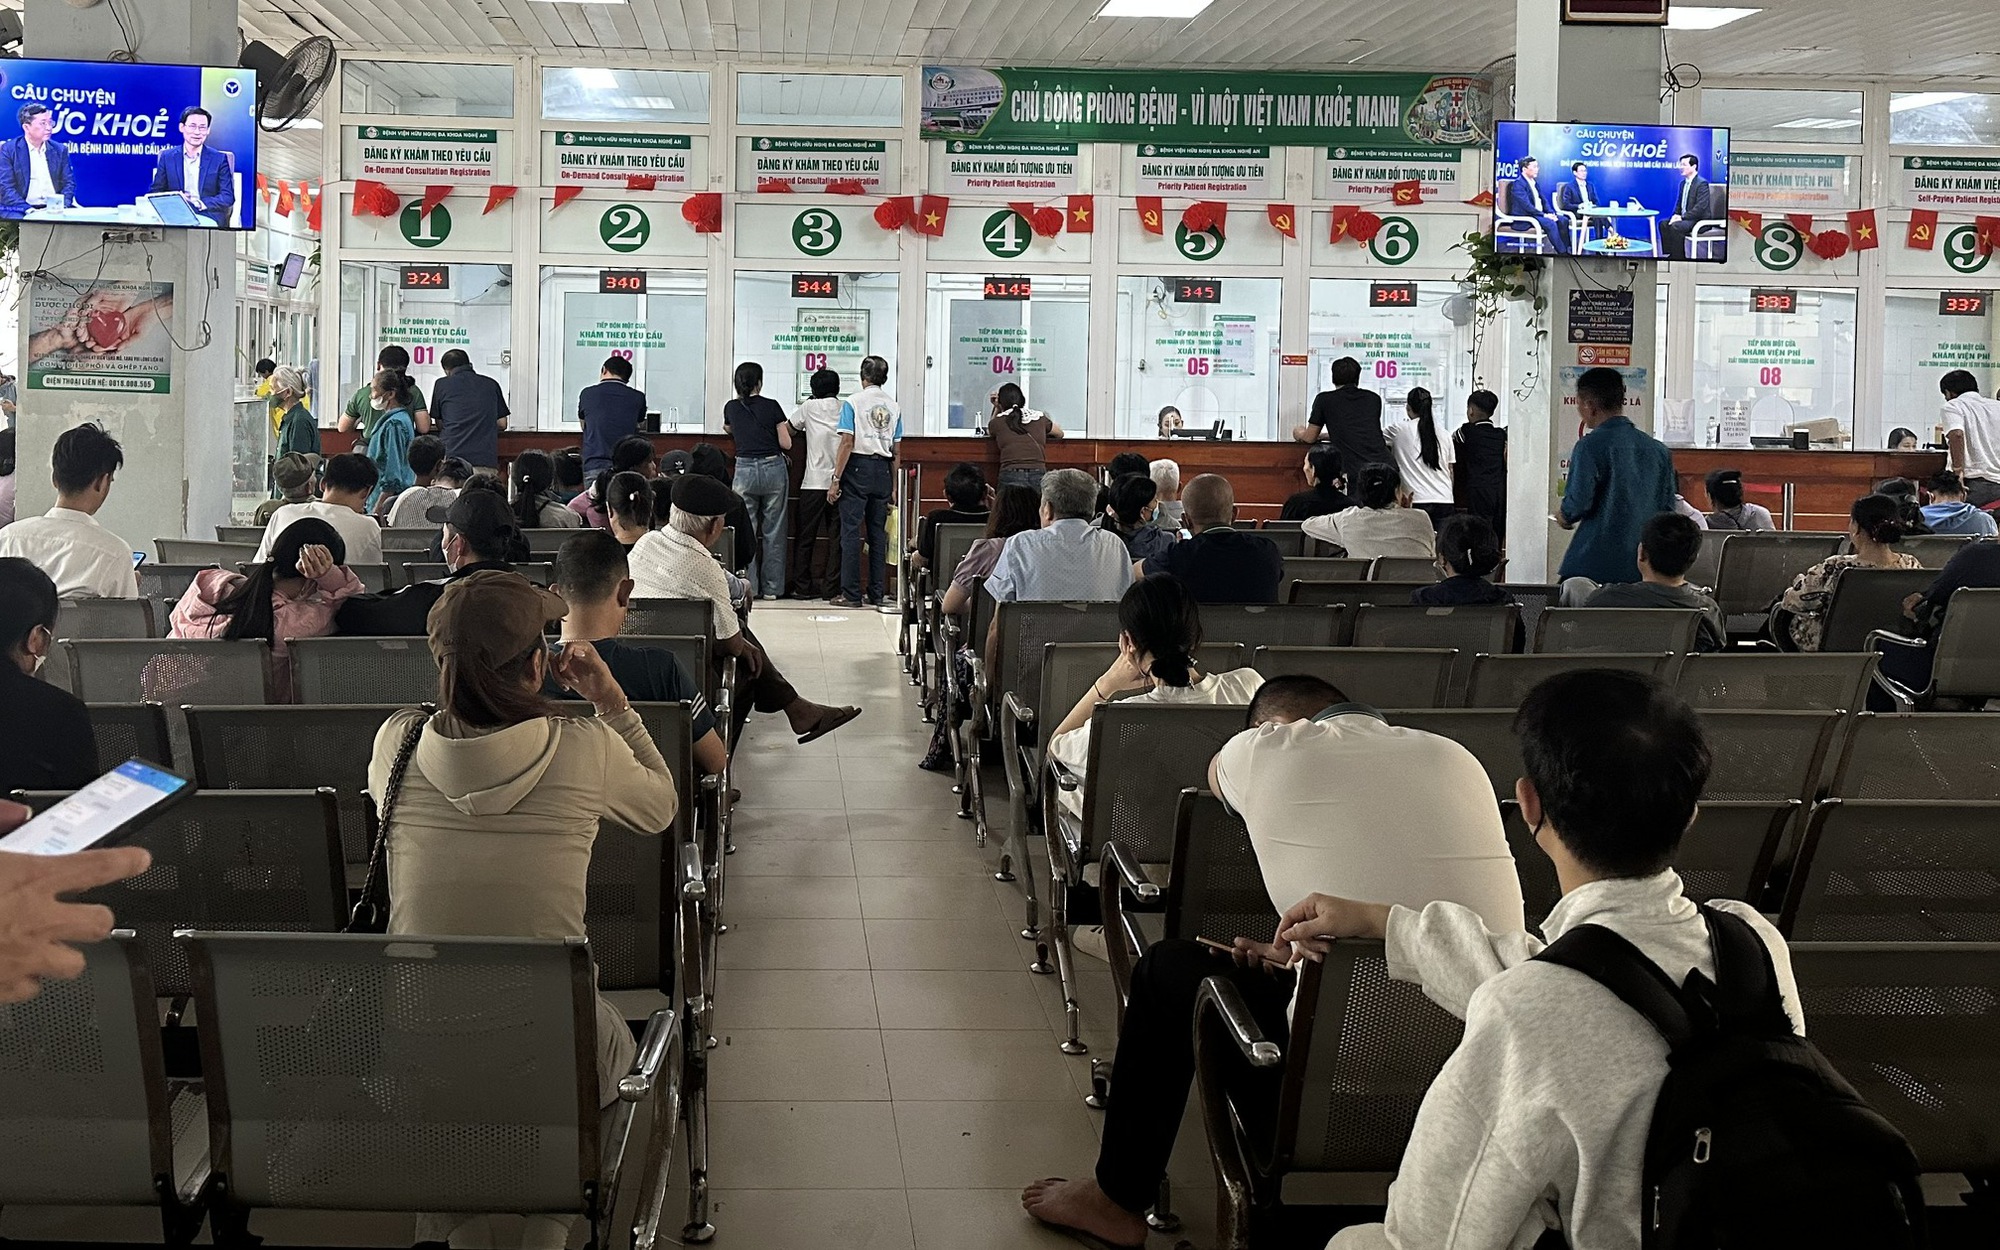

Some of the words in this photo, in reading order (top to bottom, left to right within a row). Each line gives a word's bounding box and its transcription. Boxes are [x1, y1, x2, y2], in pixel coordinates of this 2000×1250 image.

[11, 83, 48, 100] CÂU
[51, 88, 116, 108] CHUYỆN
[1012, 80, 1039, 122] CHỦ
[1044, 85, 1082, 130] ĐỘNG
[1087, 85, 1135, 125] PHÒNG
[1139, 87, 1177, 131] BỆNH
[1192, 88, 1204, 125] VÌ
[1209, 88, 1240, 132] MỘT
[1243, 89, 1273, 133] VIỆT
[1277, 95, 1310, 126] NAM
[1315, 84, 1352, 127] KHỎE
[1356, 96, 1400, 133] MẠNH
[50, 103, 86, 135] ỨC
[1576, 129, 1596, 138] CÂU
[1597, 130, 1634, 141] CHUYỆN
[80, 143, 101, 156] BỆNH
[364, 146, 387, 159] ĐĂNG
[391, 146, 401, 160] KÝ
[404, 147, 429, 160] KHÁM
[432, 150, 452, 161] THEO
[455, 148, 471, 161] YÊU
[1581, 138, 1617, 157] SỨC
[561, 152, 584, 164] ĐĂNG
[587, 153, 596, 165] KÝ
[600, 152, 624, 166] KHÁM
[627, 156, 647, 166] THEO
[650, 154, 665, 167] YÊU
[758, 157, 780, 170] ĐĂNG
[783, 158, 793, 170] KÝ
[796, 158, 819, 170] KHÁM
[822, 160, 842, 171] THEO
[846, 158, 860, 171] YÊU
[365, 166, 404, 174] On-Demand
[406, 167, 448, 175] Consultation
[450, 168, 490, 176] Registration
[561, 171, 599, 179] On-Demand
[951, 160, 970, 172] ĐĂNG
[973, 160, 982, 172] KÝ
[984, 160, 1004, 173] KHÁM
[1006, 159, 1018, 173] ĐỐI
[1021, 161, 1043, 176] TƯỢNG
[1057, 161, 1072, 174] TIÊN
[1142, 163, 1161, 175] ĐĂNG
[1164, 163, 1173, 176] KÝ
[1175, 163, 1195, 176] KHÁM
[1198, 162, 1209, 176] ĐỐI
[1212, 165, 1234, 179] TƯỢNG
[1248, 164, 1264, 177] TIÊN
[1333, 166, 1352, 179] ĐĂNG
[1354, 166, 1363, 179] KÝ
[1366, 166, 1386, 180] KHÁM
[1389, 165, 1400, 180] ĐỐI
[1439, 168, 1455, 181] TIÊN
[968, 179, 991, 188] Priority
[993, 179, 1015, 187] Patient
[1017, 180, 1055, 188] Registration
[1158, 182, 1181, 190] Priority
[1208, 183, 1246, 191] Registration
[1730, 172, 1749, 185] ĂNG
[1766, 173, 1792, 186] KHÁM
[1915, 175, 1939, 188] ĐĂNG
[1942, 176, 1953, 189] KÝ
[1956, 176, 1981, 189] KHÁM
[1349, 186, 1372, 194] Priority
[1918, 195, 1954, 203] Self-Paying
[410, 206, 440, 240] 1
[607, 208, 642, 244] 2
[800, 213, 835, 249] 3
[985, 213, 1021, 251] 4
[1383, 224, 1411, 259] 6
[1761, 227, 1797, 266] 8
[1952, 231, 1985, 269] 9
[407, 273, 442, 285] 324
[606, 278, 640, 289] 340
[798, 281, 831, 294] 344
[985, 283, 1031, 296] A145
[1182, 287, 1214, 298] 345
[1377, 290, 1410, 302] 341
[1757, 295, 1791, 308] 333
[1947, 298, 1981, 311] 337
[414, 346, 433, 364] 01
[806, 353, 826, 371] 03
[993, 355, 1014, 373] 04
[1188, 358, 1208, 376] 05
[1376, 360, 1397, 378] 06
[1760, 367, 1781, 385] 08
